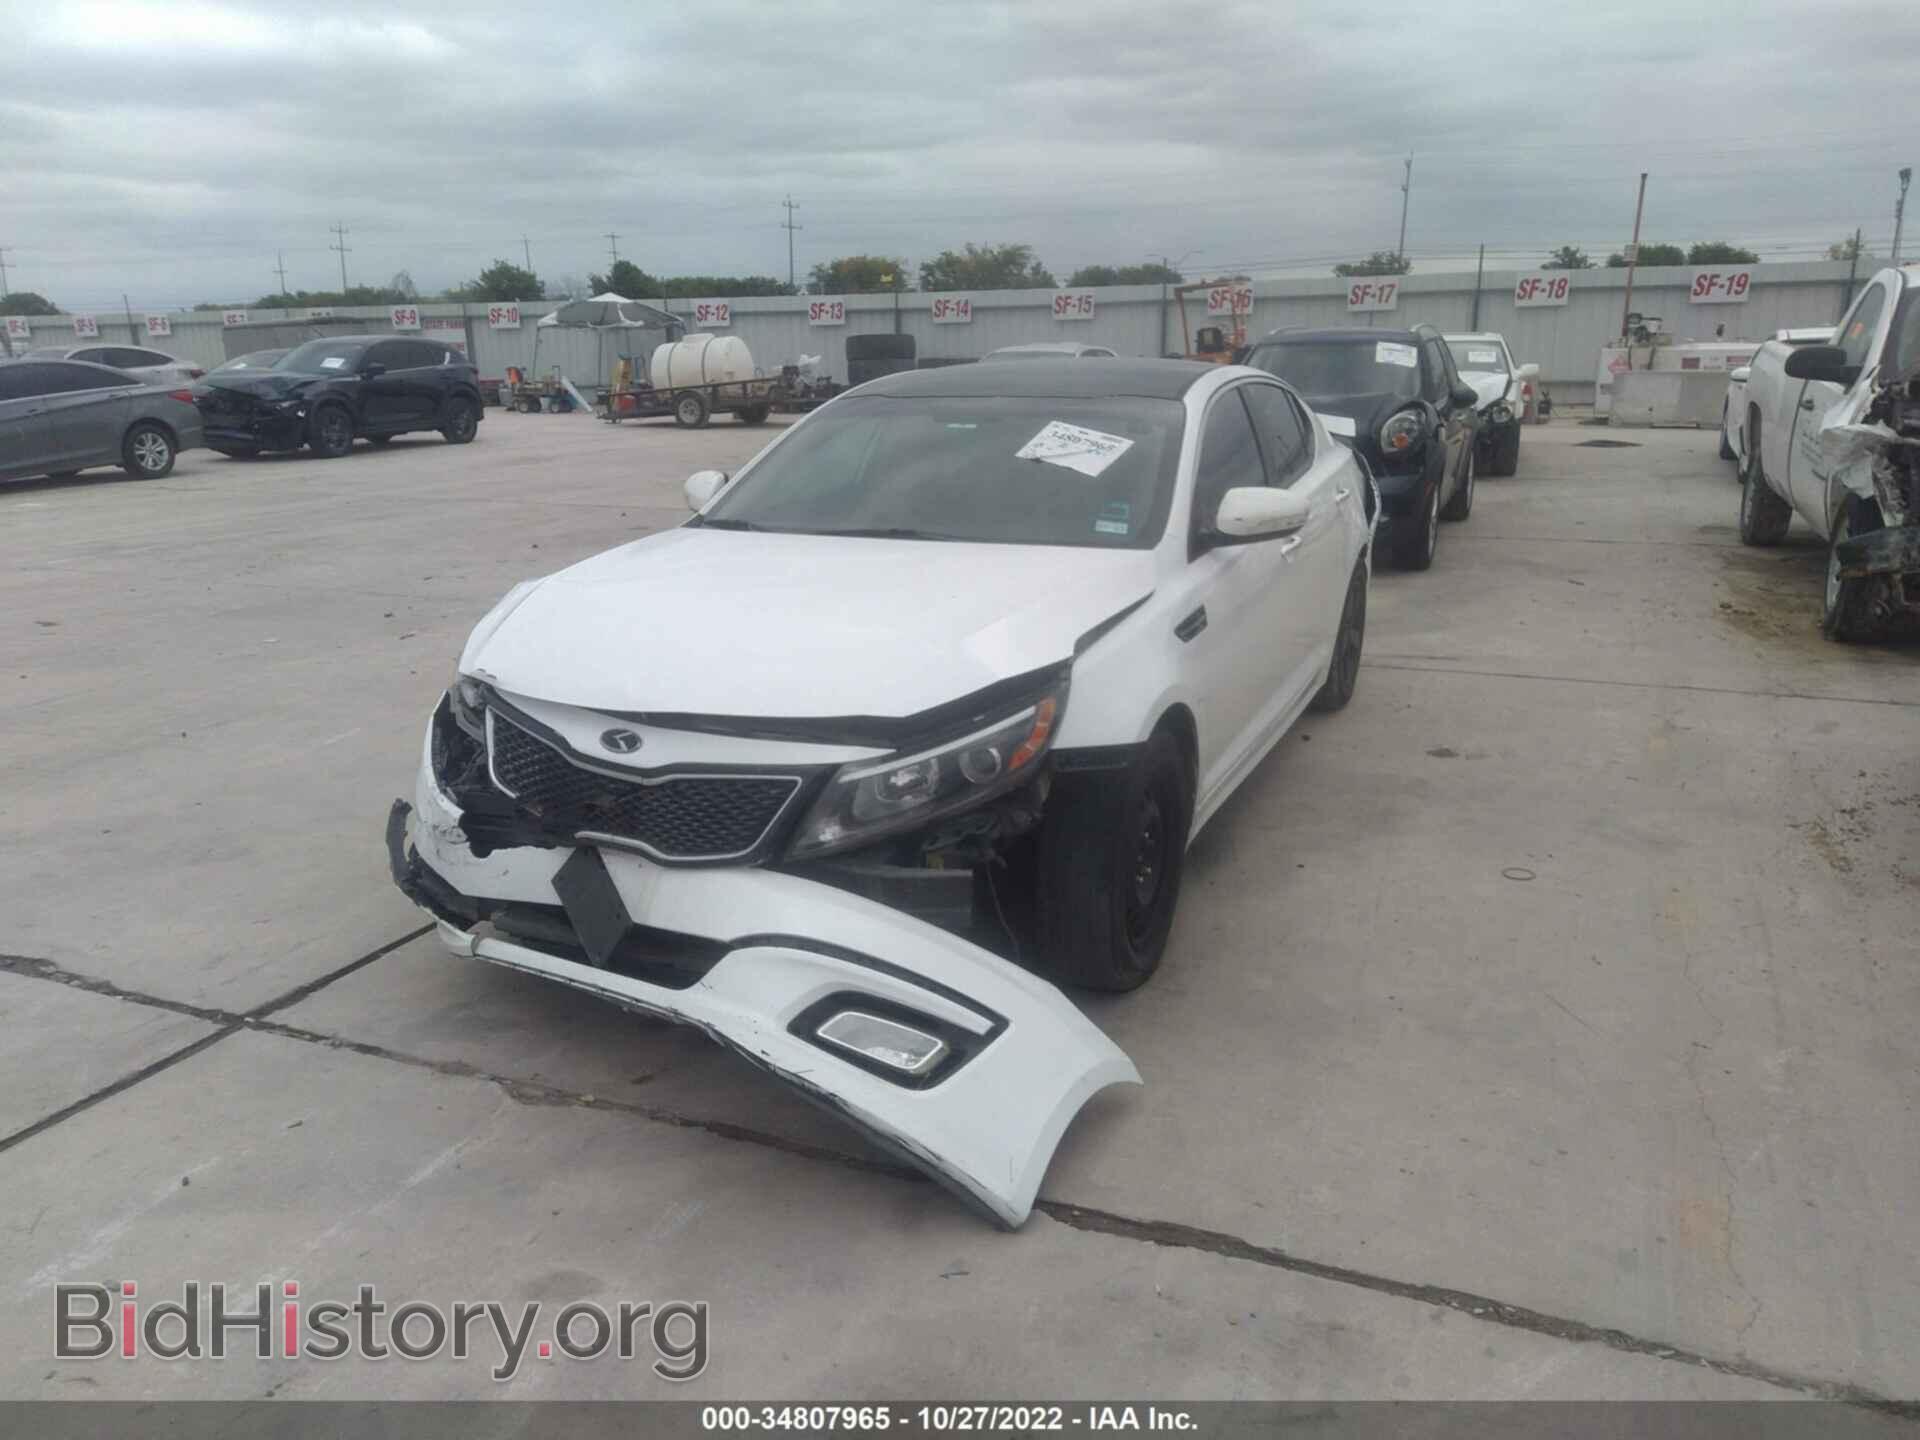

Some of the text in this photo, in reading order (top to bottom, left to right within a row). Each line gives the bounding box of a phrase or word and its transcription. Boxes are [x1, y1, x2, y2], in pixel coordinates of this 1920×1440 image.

[1516, 277, 1568, 300] SF-18
[1693, 272, 1749, 296] SF-19
[1350, 283, 1396, 305] SF-17
[697, 304, 728, 321] SF-12
[810, 302, 843, 320] SF-13
[934, 299, 969, 318] SF-14
[1055, 295, 1094, 315] SF-15
[394, 309, 417, 325] SF-9
[490, 306, 518, 325] SF-10
